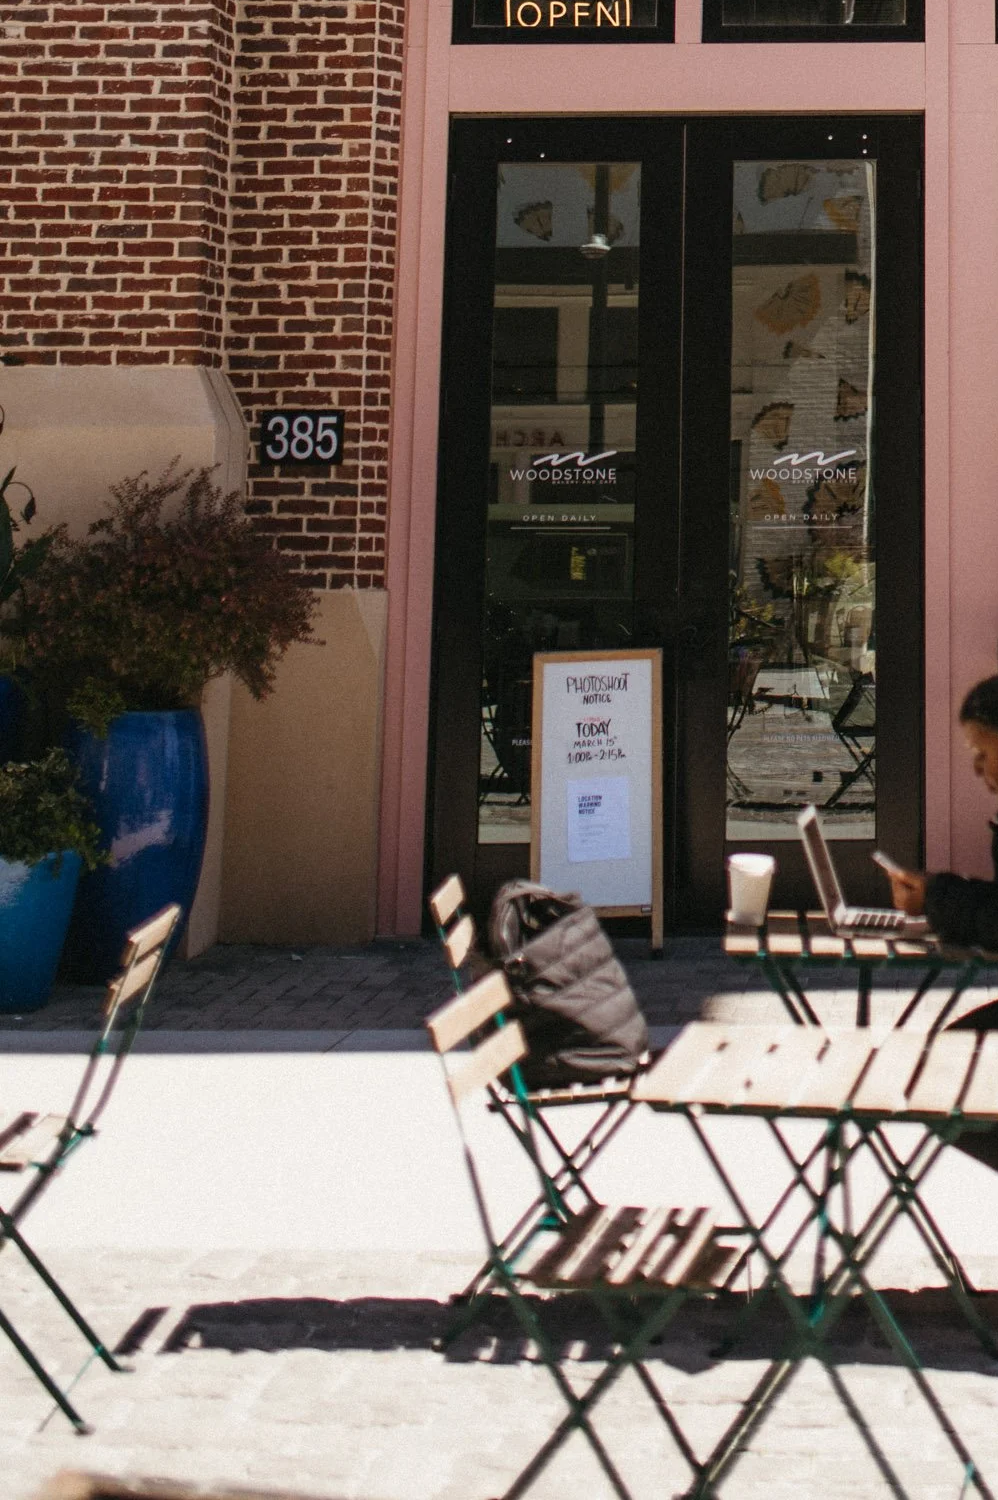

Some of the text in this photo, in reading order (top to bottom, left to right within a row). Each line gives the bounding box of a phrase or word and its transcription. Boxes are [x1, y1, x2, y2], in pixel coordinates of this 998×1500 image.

[517, 1, 620, 27] OPEN
[266, 415, 338, 460] 385
[510, 468, 617, 481] WOODSTONE
[750, 468, 857, 480] WOODSTONE
[522, 514, 597, 522] OPEN DAILY
[566, 673, 630, 694] PHOTOSHOOT
[582, 693, 612, 705] NOTICE
[576, 718, 612, 738] TODAY
[573, 739, 602, 749] MARCH
